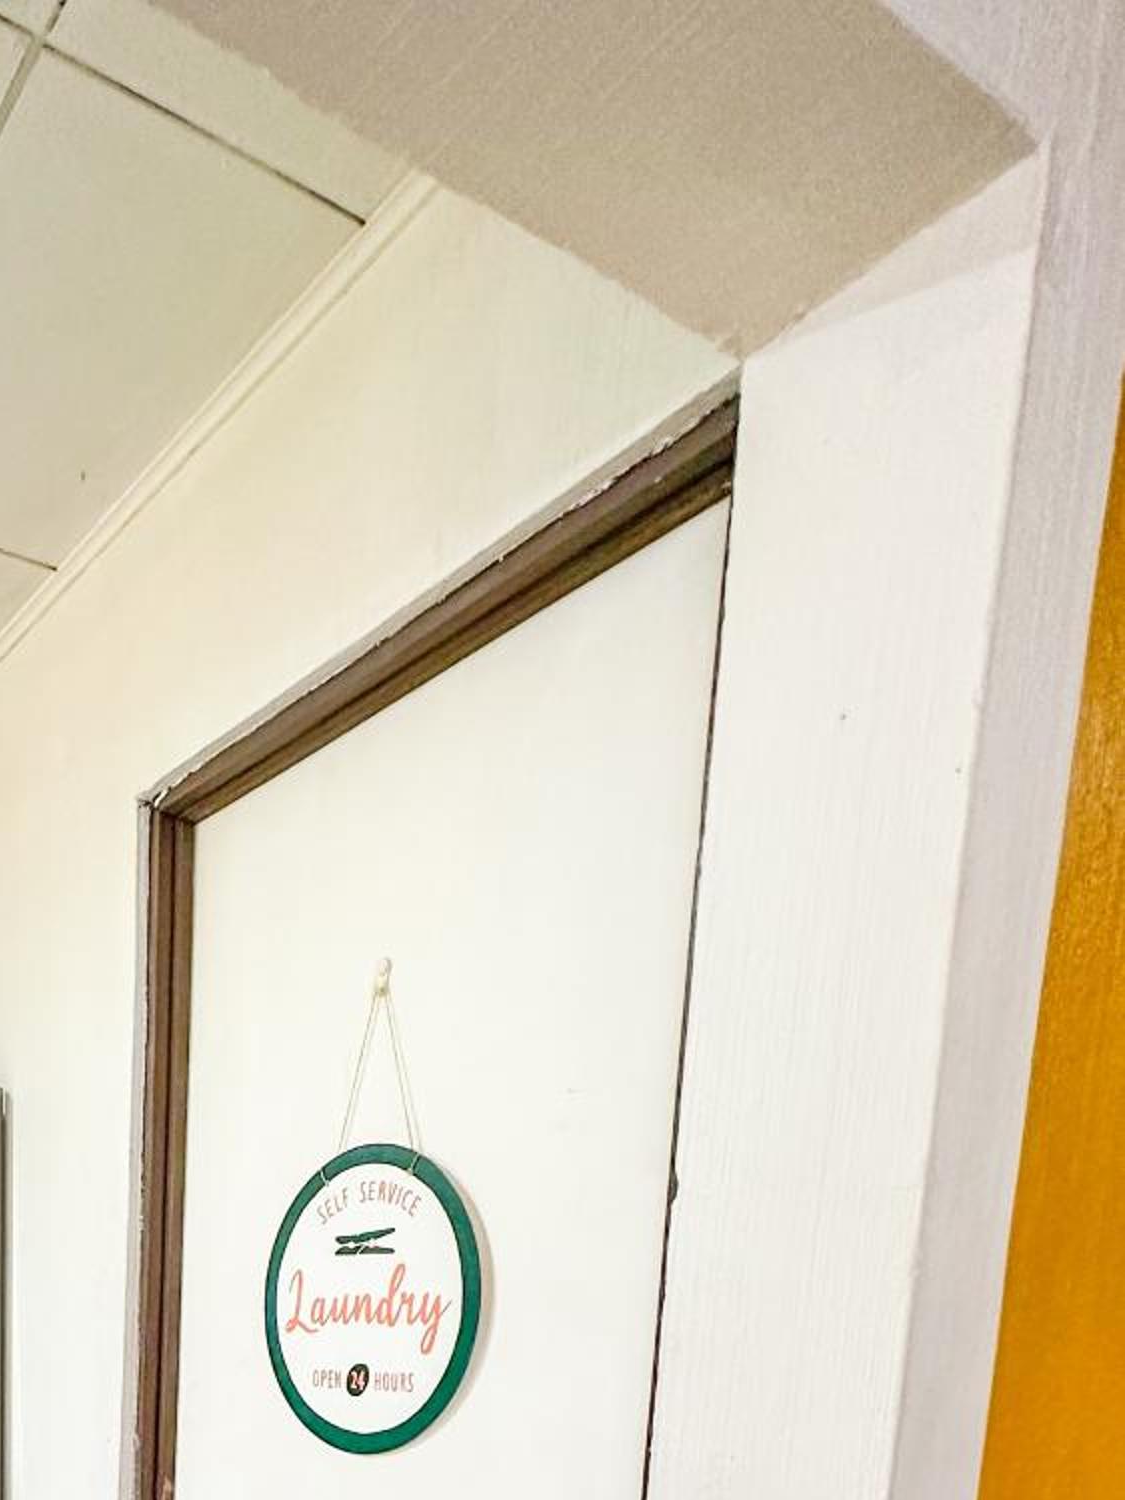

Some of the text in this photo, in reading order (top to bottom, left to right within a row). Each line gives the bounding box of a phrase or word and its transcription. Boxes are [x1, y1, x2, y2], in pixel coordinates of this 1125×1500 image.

[317, 1181, 421, 1224] SELF SERVICE
[286, 1263, 452, 1355] Laundry
[313, 1369, 414, 1392] OPEN 24 HOURS
